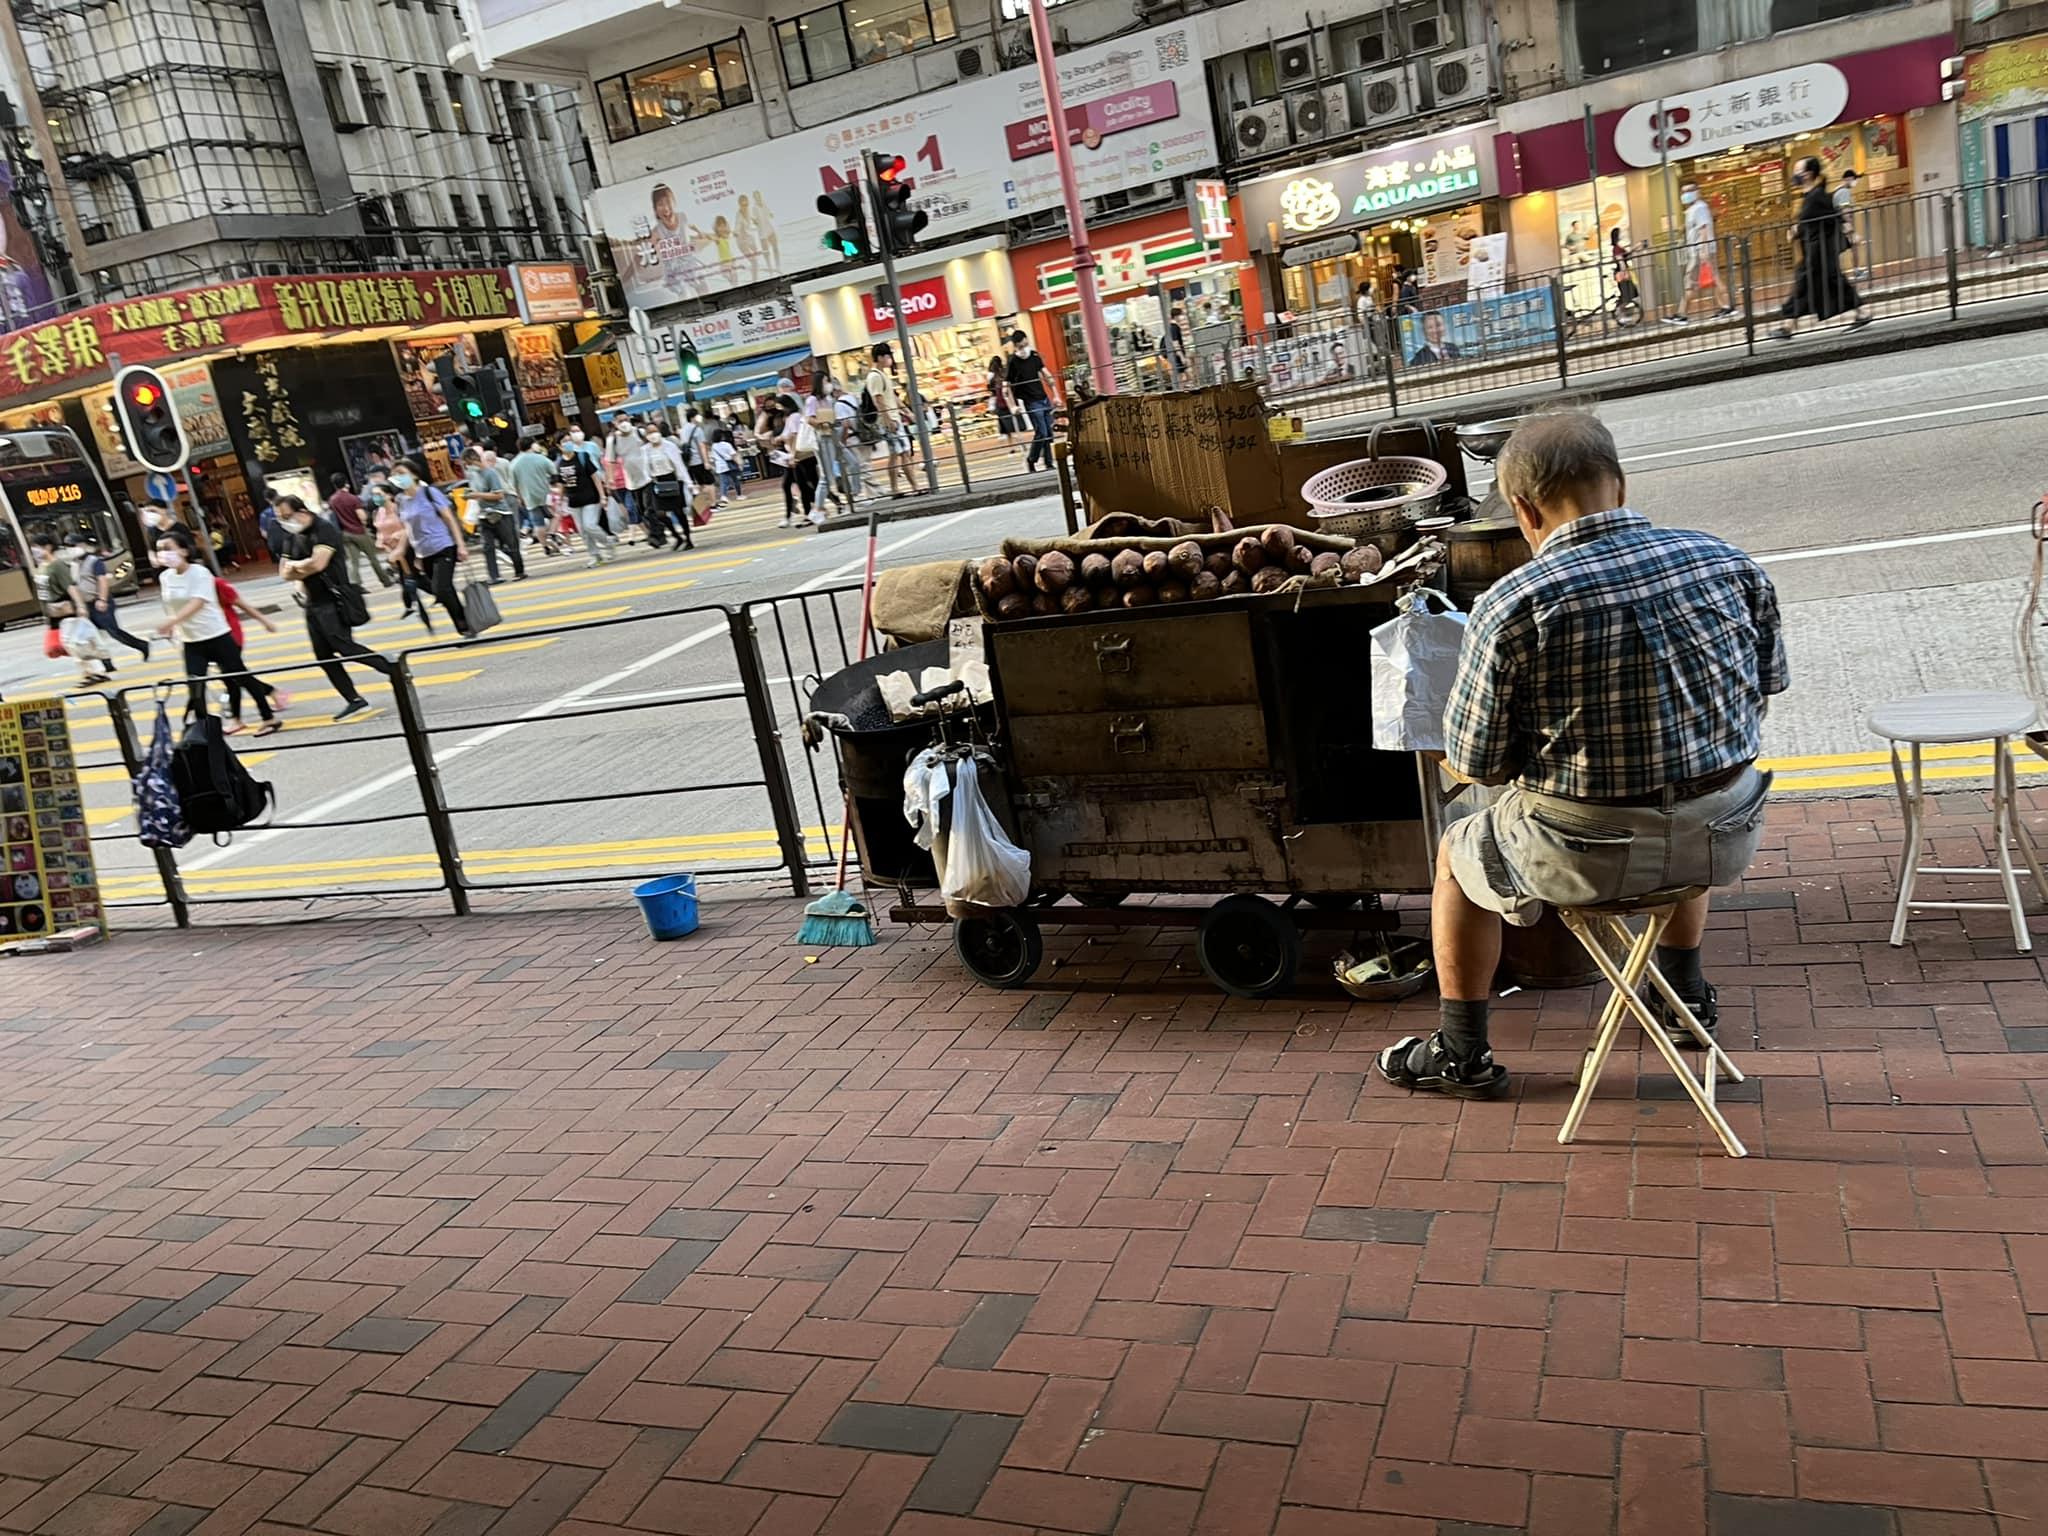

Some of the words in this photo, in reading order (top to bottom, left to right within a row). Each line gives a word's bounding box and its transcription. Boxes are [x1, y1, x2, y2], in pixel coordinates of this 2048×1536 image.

[1697, 79, 1811, 123] 大新銀行
[1352, 169, 1479, 214] AQUADELI
[4, 315, 104, 385] 毛澤東
[161, 318, 225, 352] 毛澤東
[59, 484, 82, 502] 116
